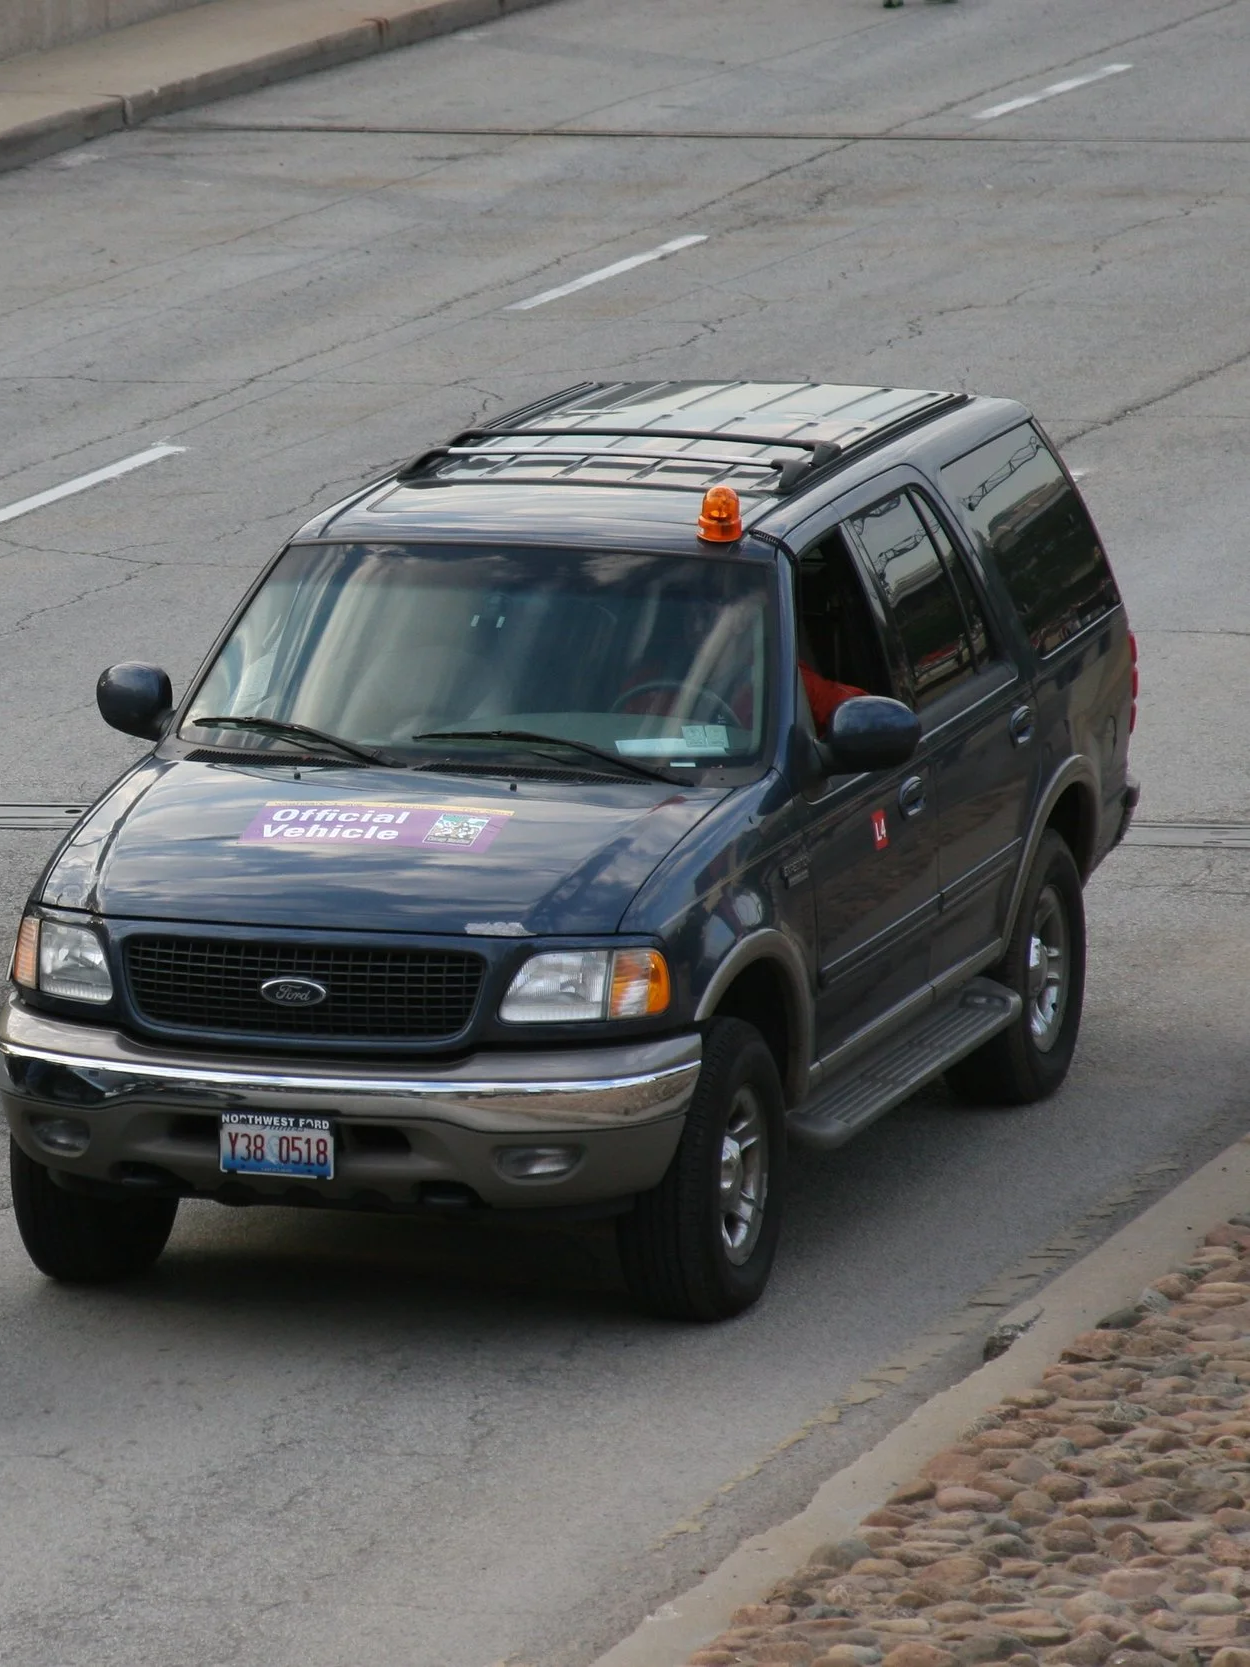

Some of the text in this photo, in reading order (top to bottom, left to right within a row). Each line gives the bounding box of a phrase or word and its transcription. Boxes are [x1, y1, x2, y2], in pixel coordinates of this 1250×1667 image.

[272, 808, 411, 824] Official
[262, 824, 399, 840] Vehicle
[874, 818, 887, 841] L4
[275, 984, 311, 1001] Ford
[228, 1132, 328, 1166] Y38 0518
